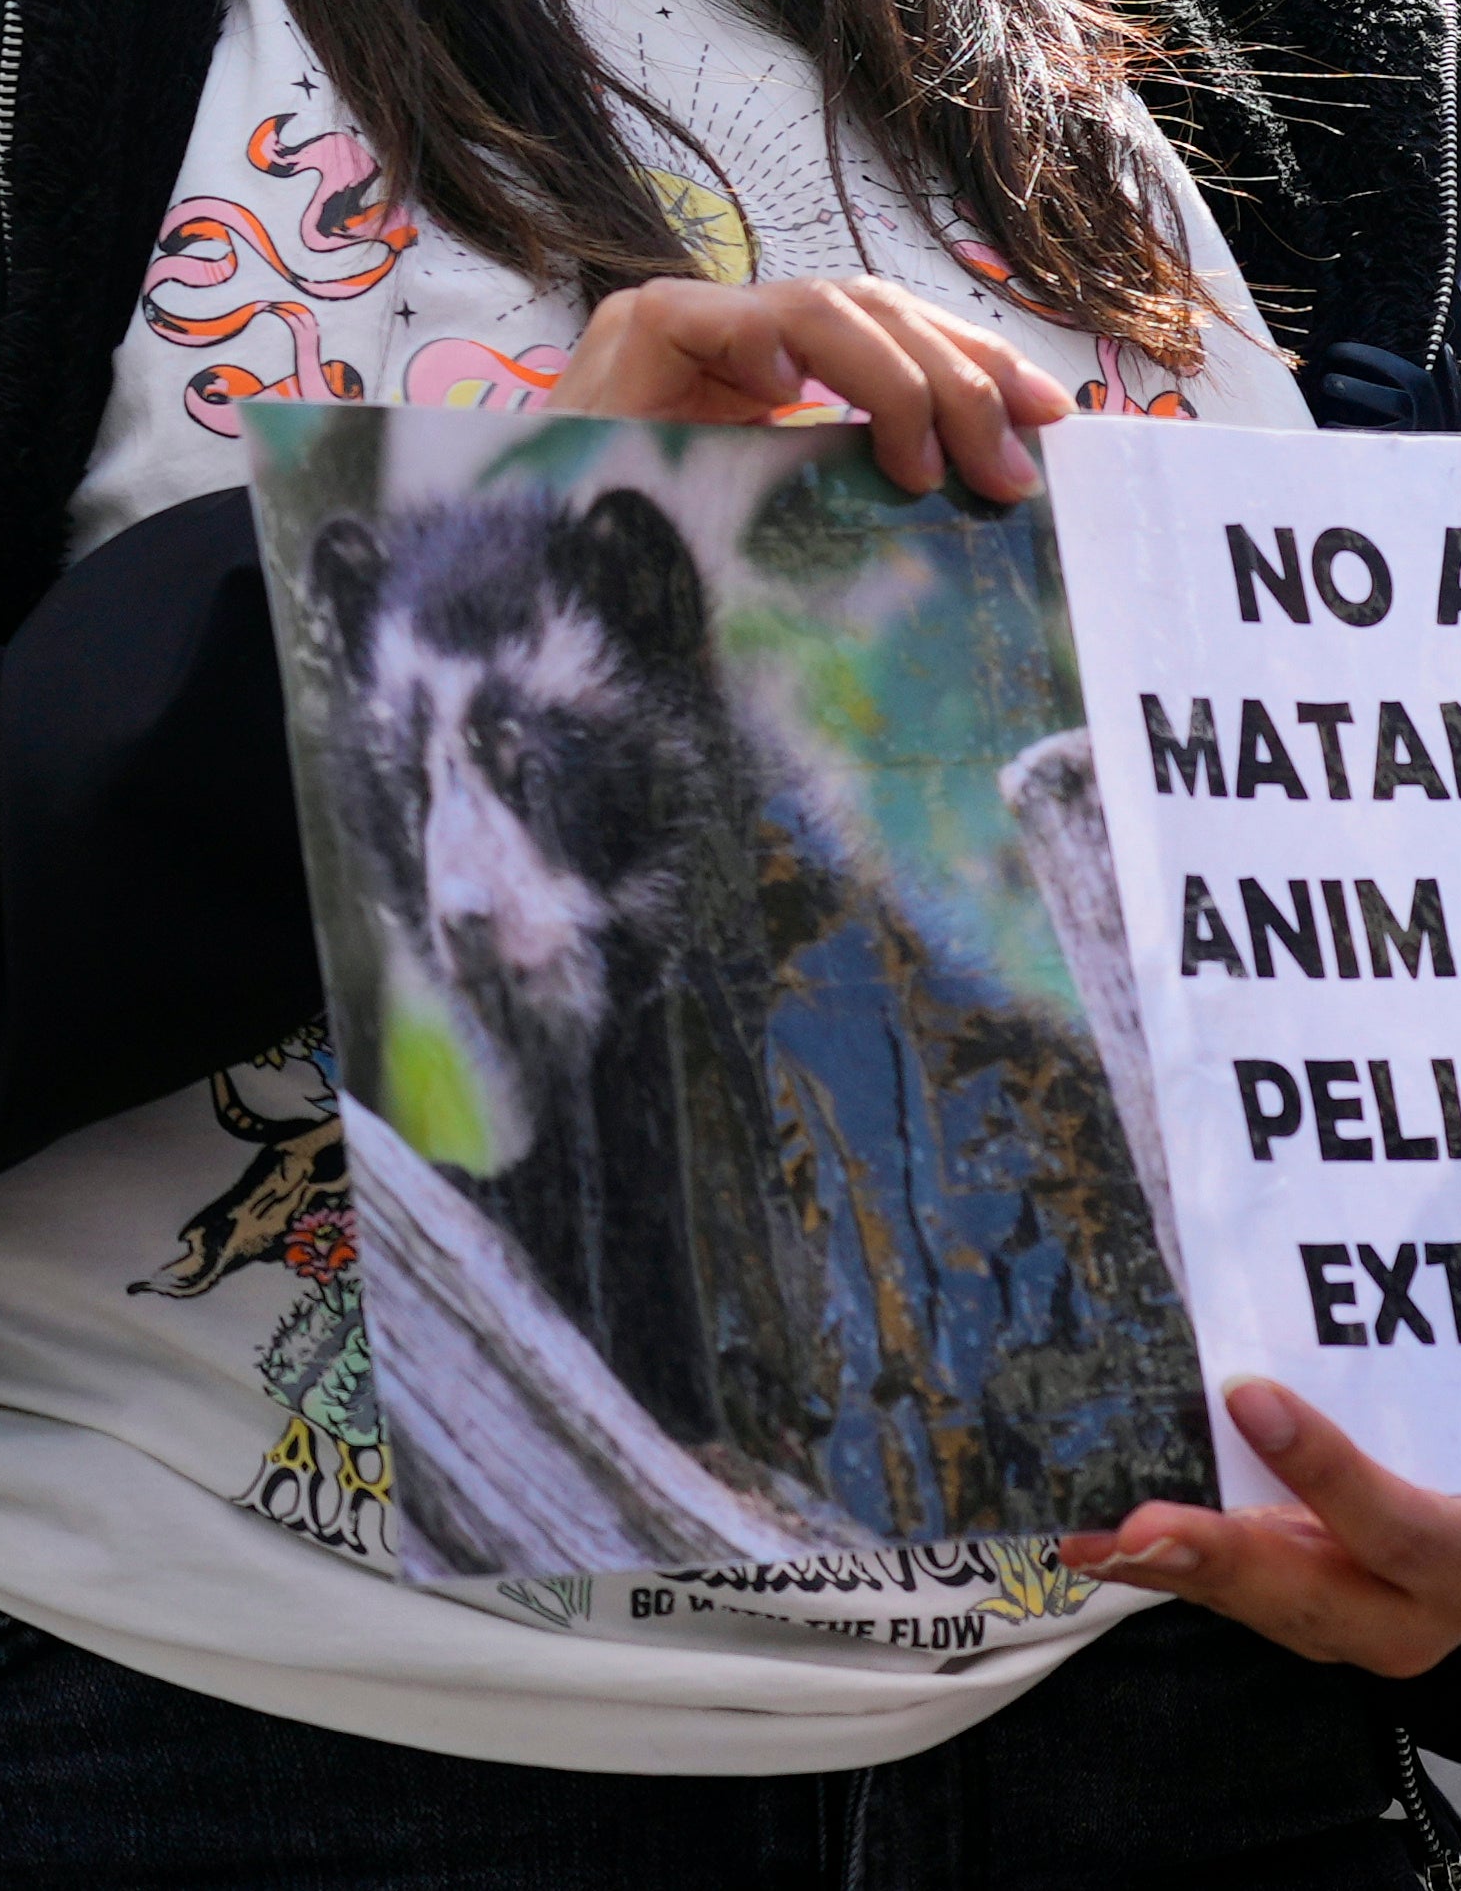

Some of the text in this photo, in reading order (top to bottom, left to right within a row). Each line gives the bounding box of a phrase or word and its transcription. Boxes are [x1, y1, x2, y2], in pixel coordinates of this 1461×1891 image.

[1225, 524, 1392, 627] NO
[631, 1589, 676, 1618] GO
[891, 1614, 986, 1649] FLOW
